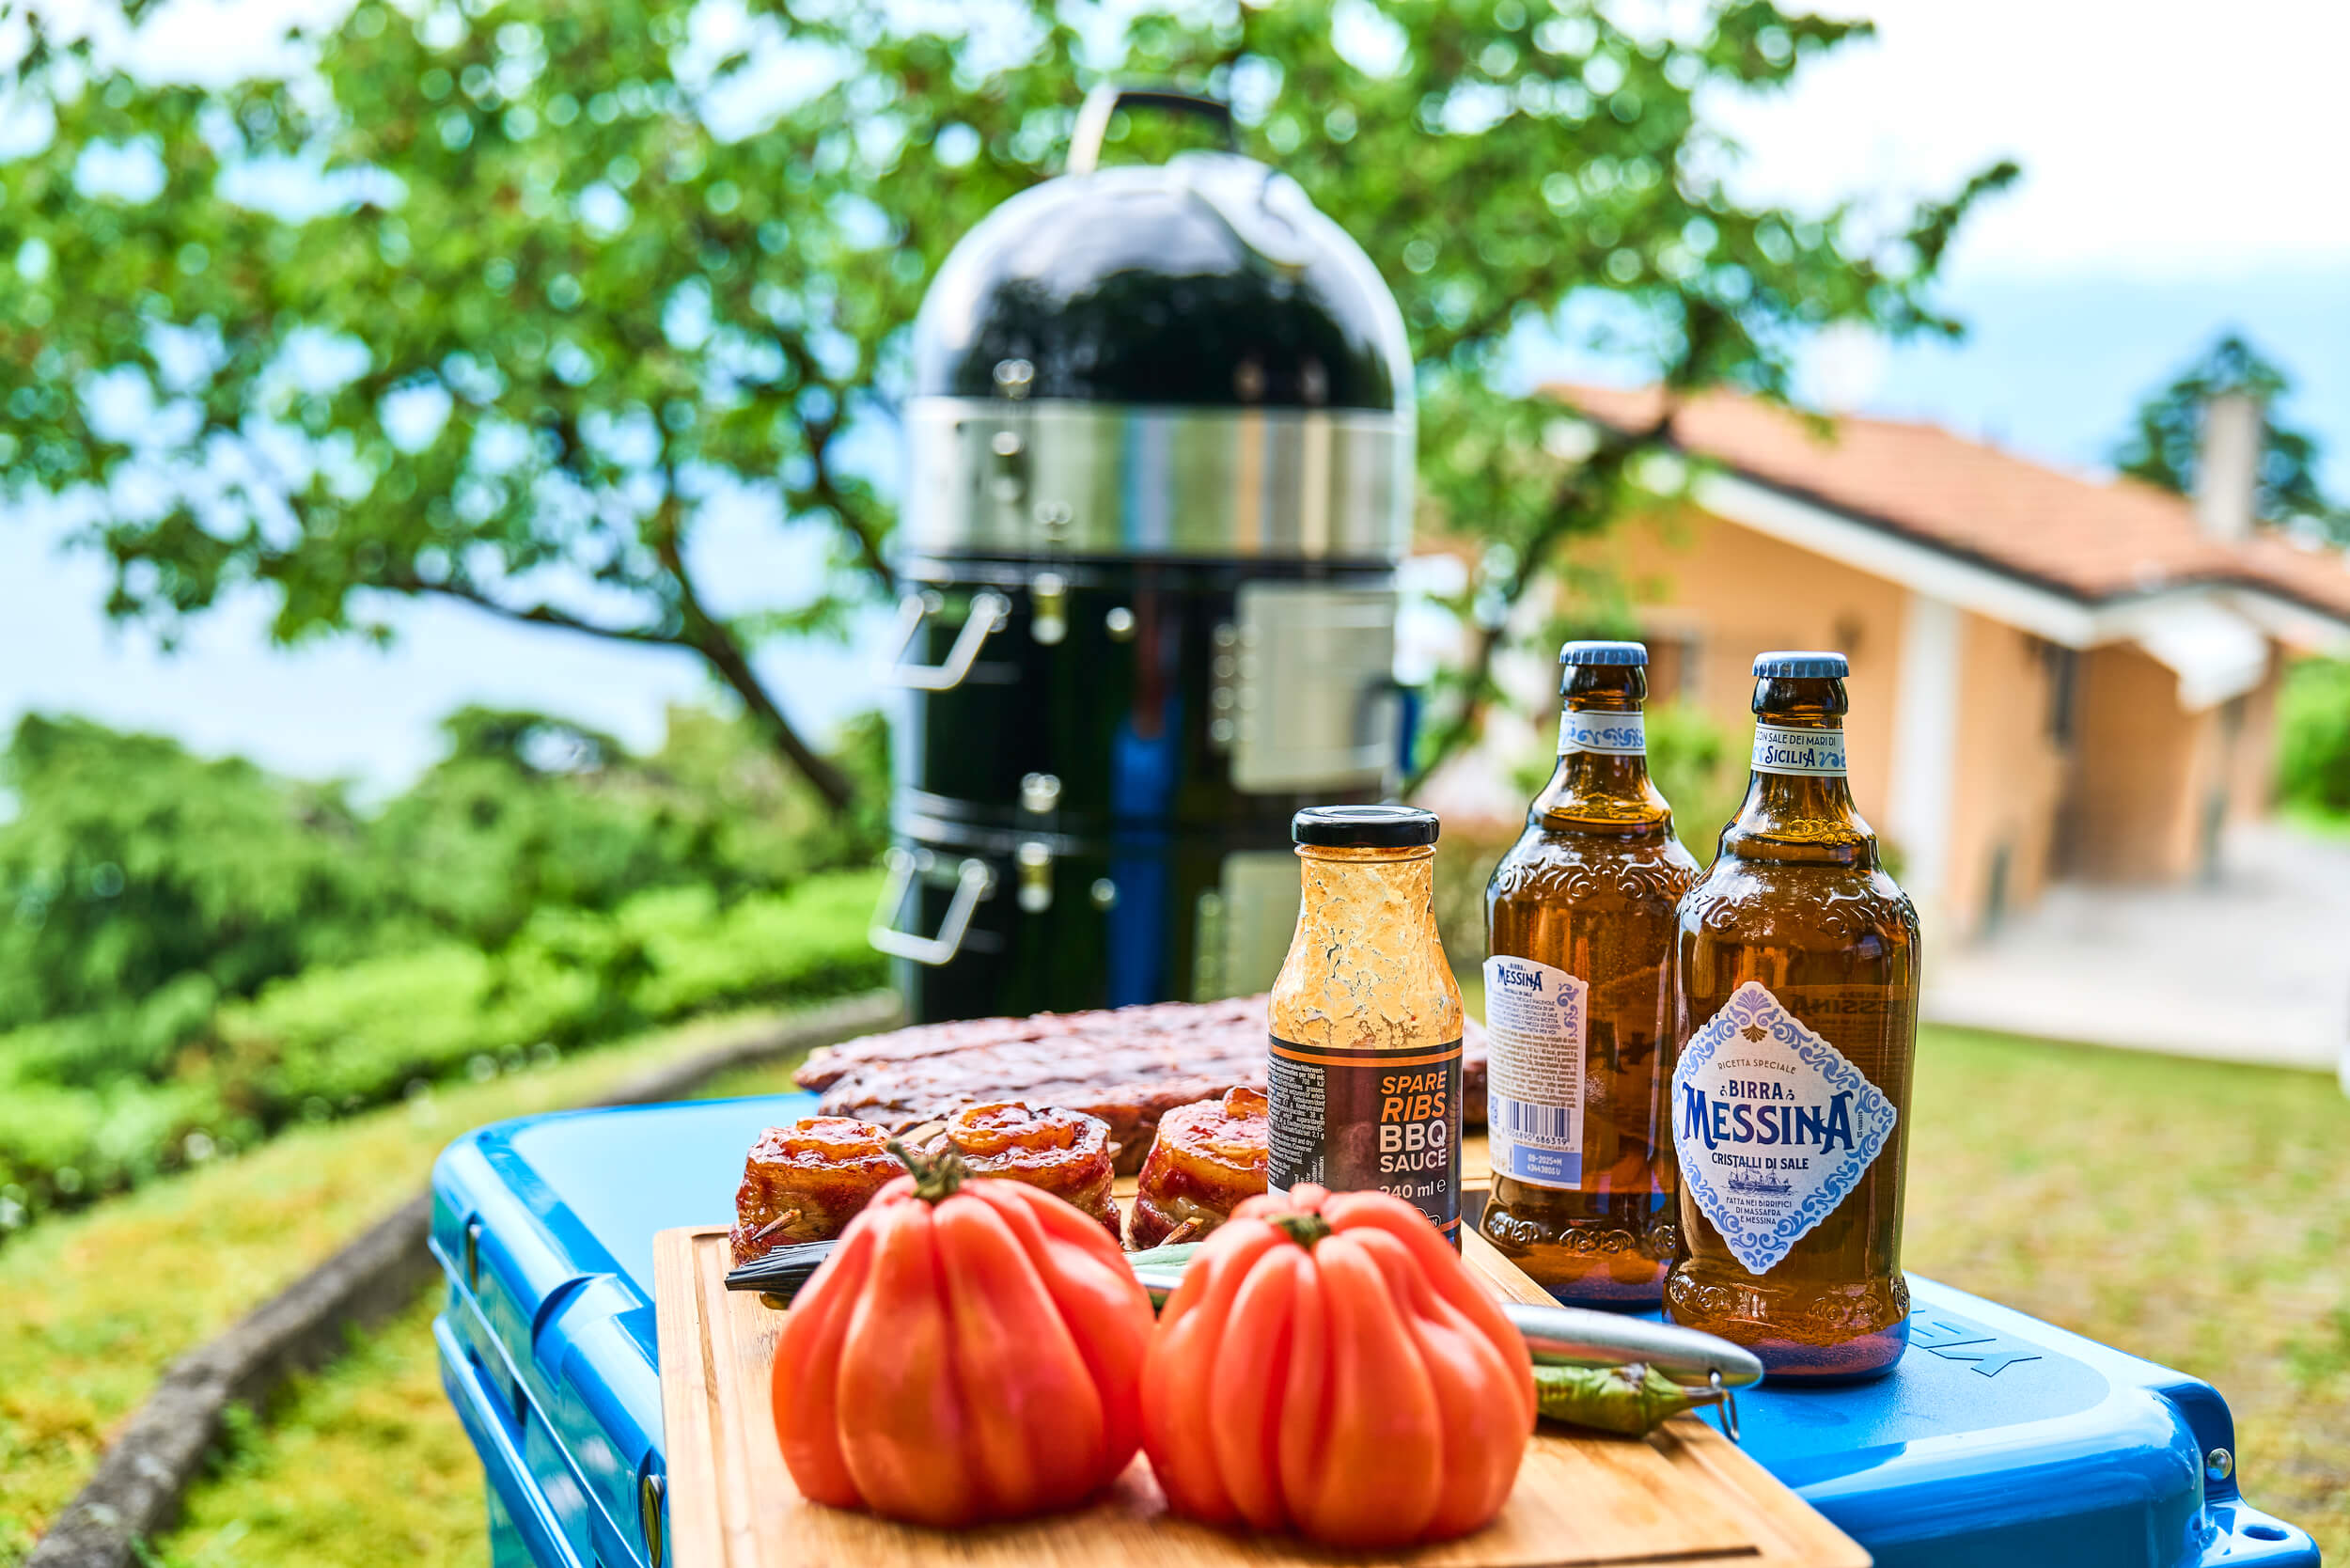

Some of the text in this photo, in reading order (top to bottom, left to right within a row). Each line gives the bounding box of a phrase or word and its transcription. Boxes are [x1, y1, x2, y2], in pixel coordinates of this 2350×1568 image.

[1768, 733, 1788, 745] SALE
[1790, 735, 1805, 745] DEI
[1806, 736, 1827, 746] MARI
[1828, 737, 1836, 746] DI
[1764, 745, 1815, 767] SICILIA
[1497, 964, 1543, 992] MESSINA
[1717, 1058, 1796, 1074] RICETTA SPECIALE
[1380, 1071, 1448, 1095] SPARE
[1729, 1079, 1783, 1100] BIRRA
[1380, 1092, 1447, 1122] RIBS
[1683, 1081, 1855, 1155] MESSINA
[1380, 1120, 1447, 1153] BBQ
[1380, 1149, 1447, 1173] SAUCE
[1712, 1152, 1810, 1169] CRISTALLI DI SALE
[1418, 1182, 1434, 1199] ml
[1726, 1197, 1792, 1208] FATTA NEI BIRRIFICI
[1744, 1207, 1781, 1216] MASSAFRA
[1746, 1216, 1777, 1225] MESSINA
